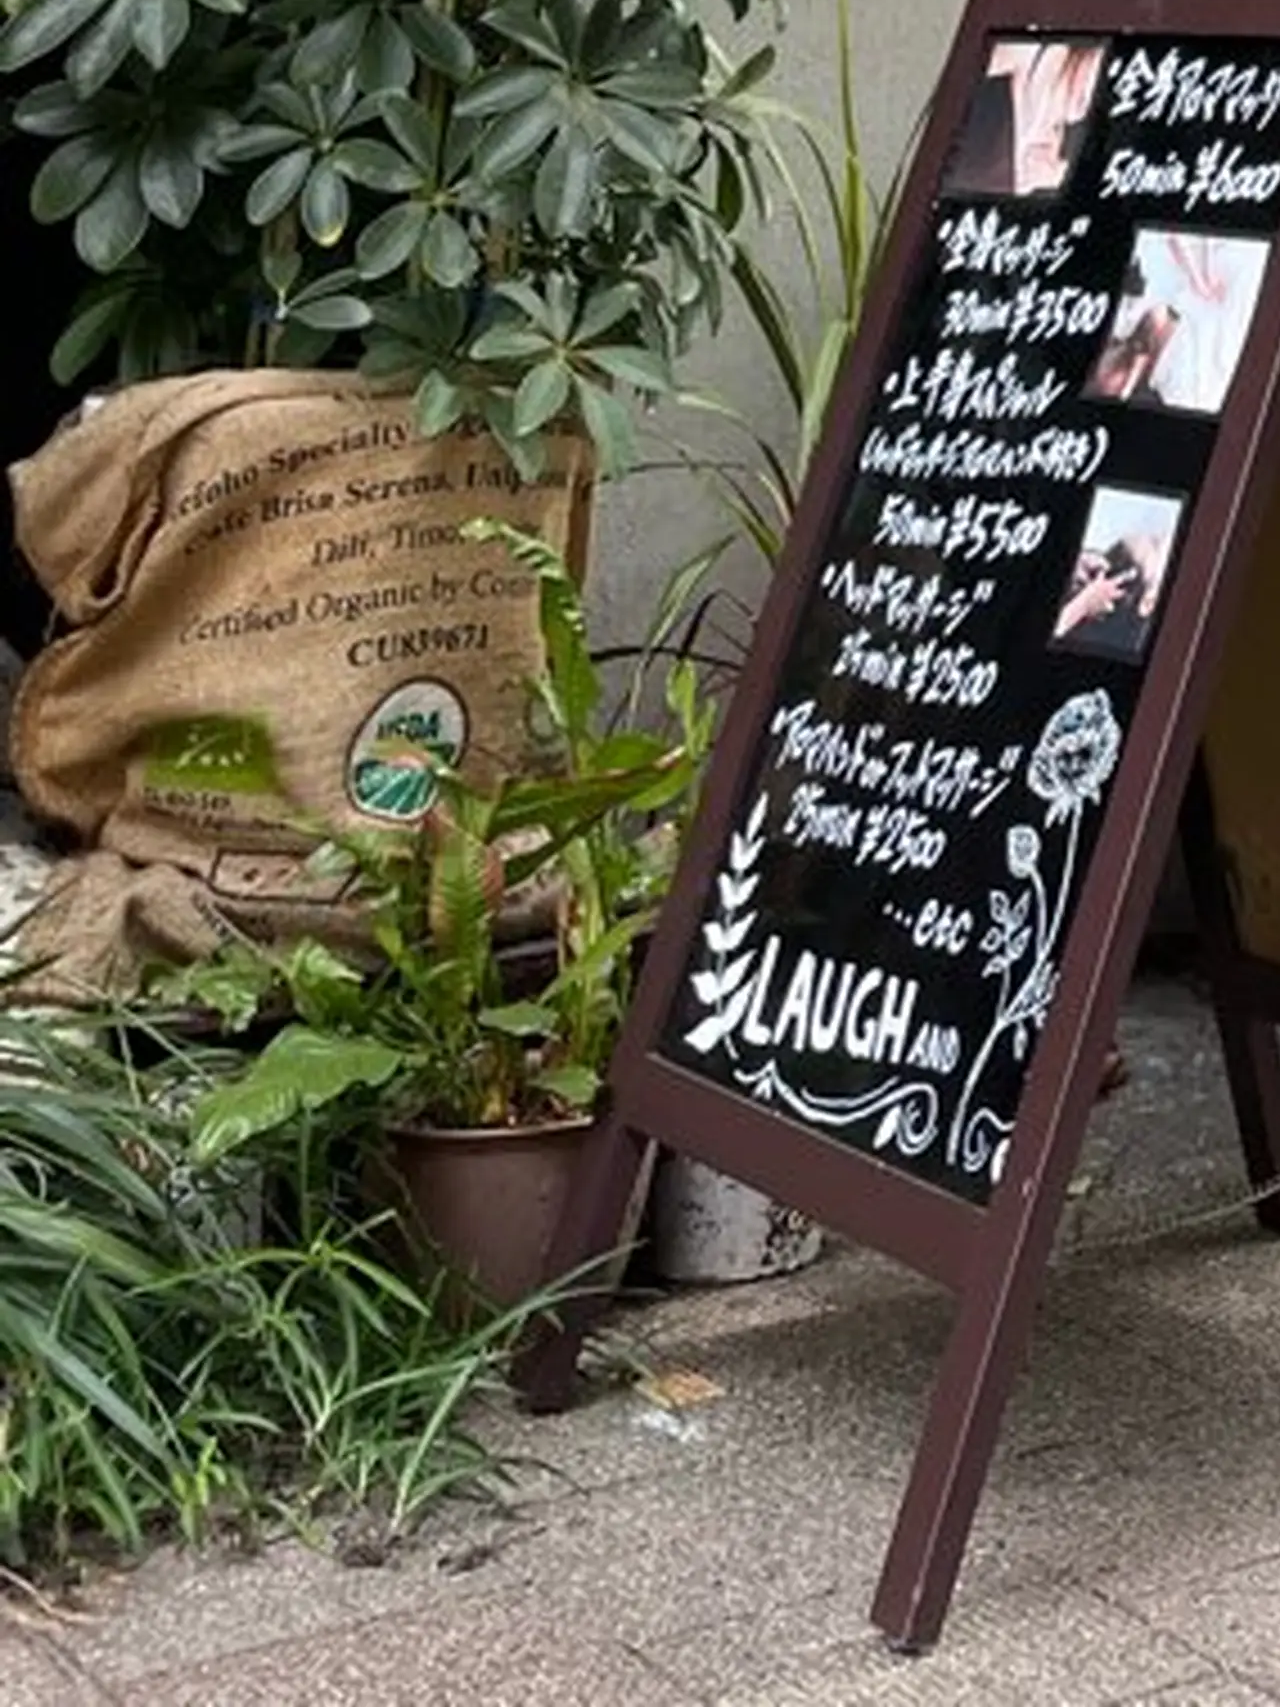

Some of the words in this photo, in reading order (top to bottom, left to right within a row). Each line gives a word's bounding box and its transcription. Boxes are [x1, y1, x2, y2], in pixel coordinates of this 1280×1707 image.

[1099, 147, 1188, 199] 50min
[1005, 277, 1110, 346] ¥3500
[267, 419, 411, 476] Specialty
[260, 487, 336, 525] Brisa
[941, 492, 1050, 564] ¥5500
[180, 598, 298, 647] Certified
[304, 580, 423, 624] Organic
[430, 571, 464, 604] by
[903, 638, 1000, 708] ¥2500
[853, 803, 947, 875] ¥2500
[743, 933, 922, 1064] LAUGH
[905, 1020, 962, 1075] AND
